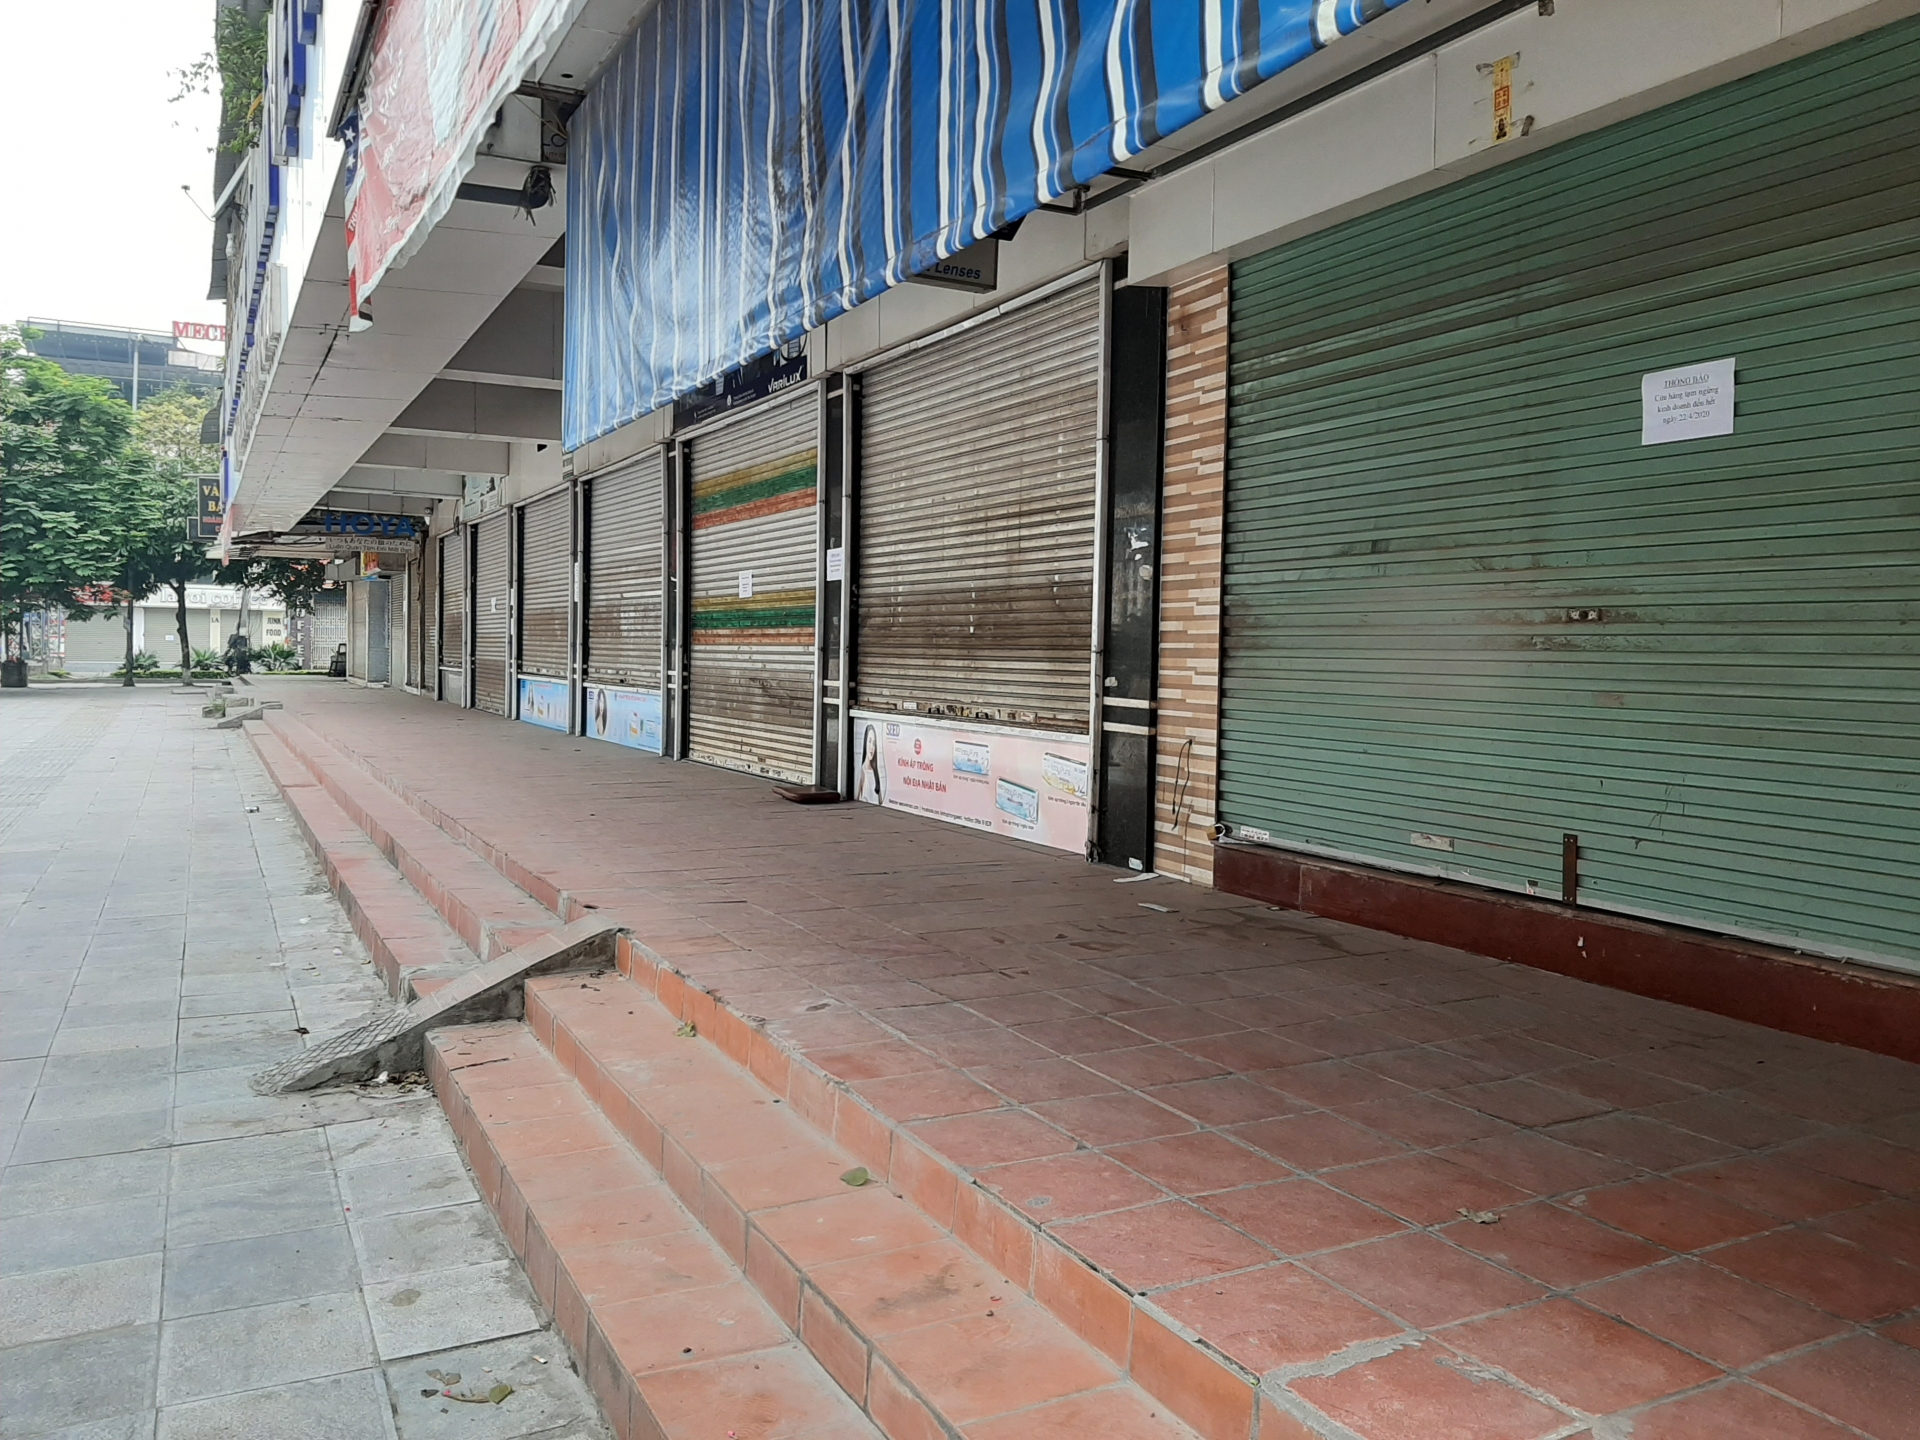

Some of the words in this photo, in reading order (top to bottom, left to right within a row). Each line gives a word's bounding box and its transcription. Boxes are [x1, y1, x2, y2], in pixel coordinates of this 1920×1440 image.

[934, 262, 981, 280] Lenses
[767, 365, 804, 393] VARILUX
[324, 512, 416, 537] HOYA
[266, 629, 281, 637] FOOD
